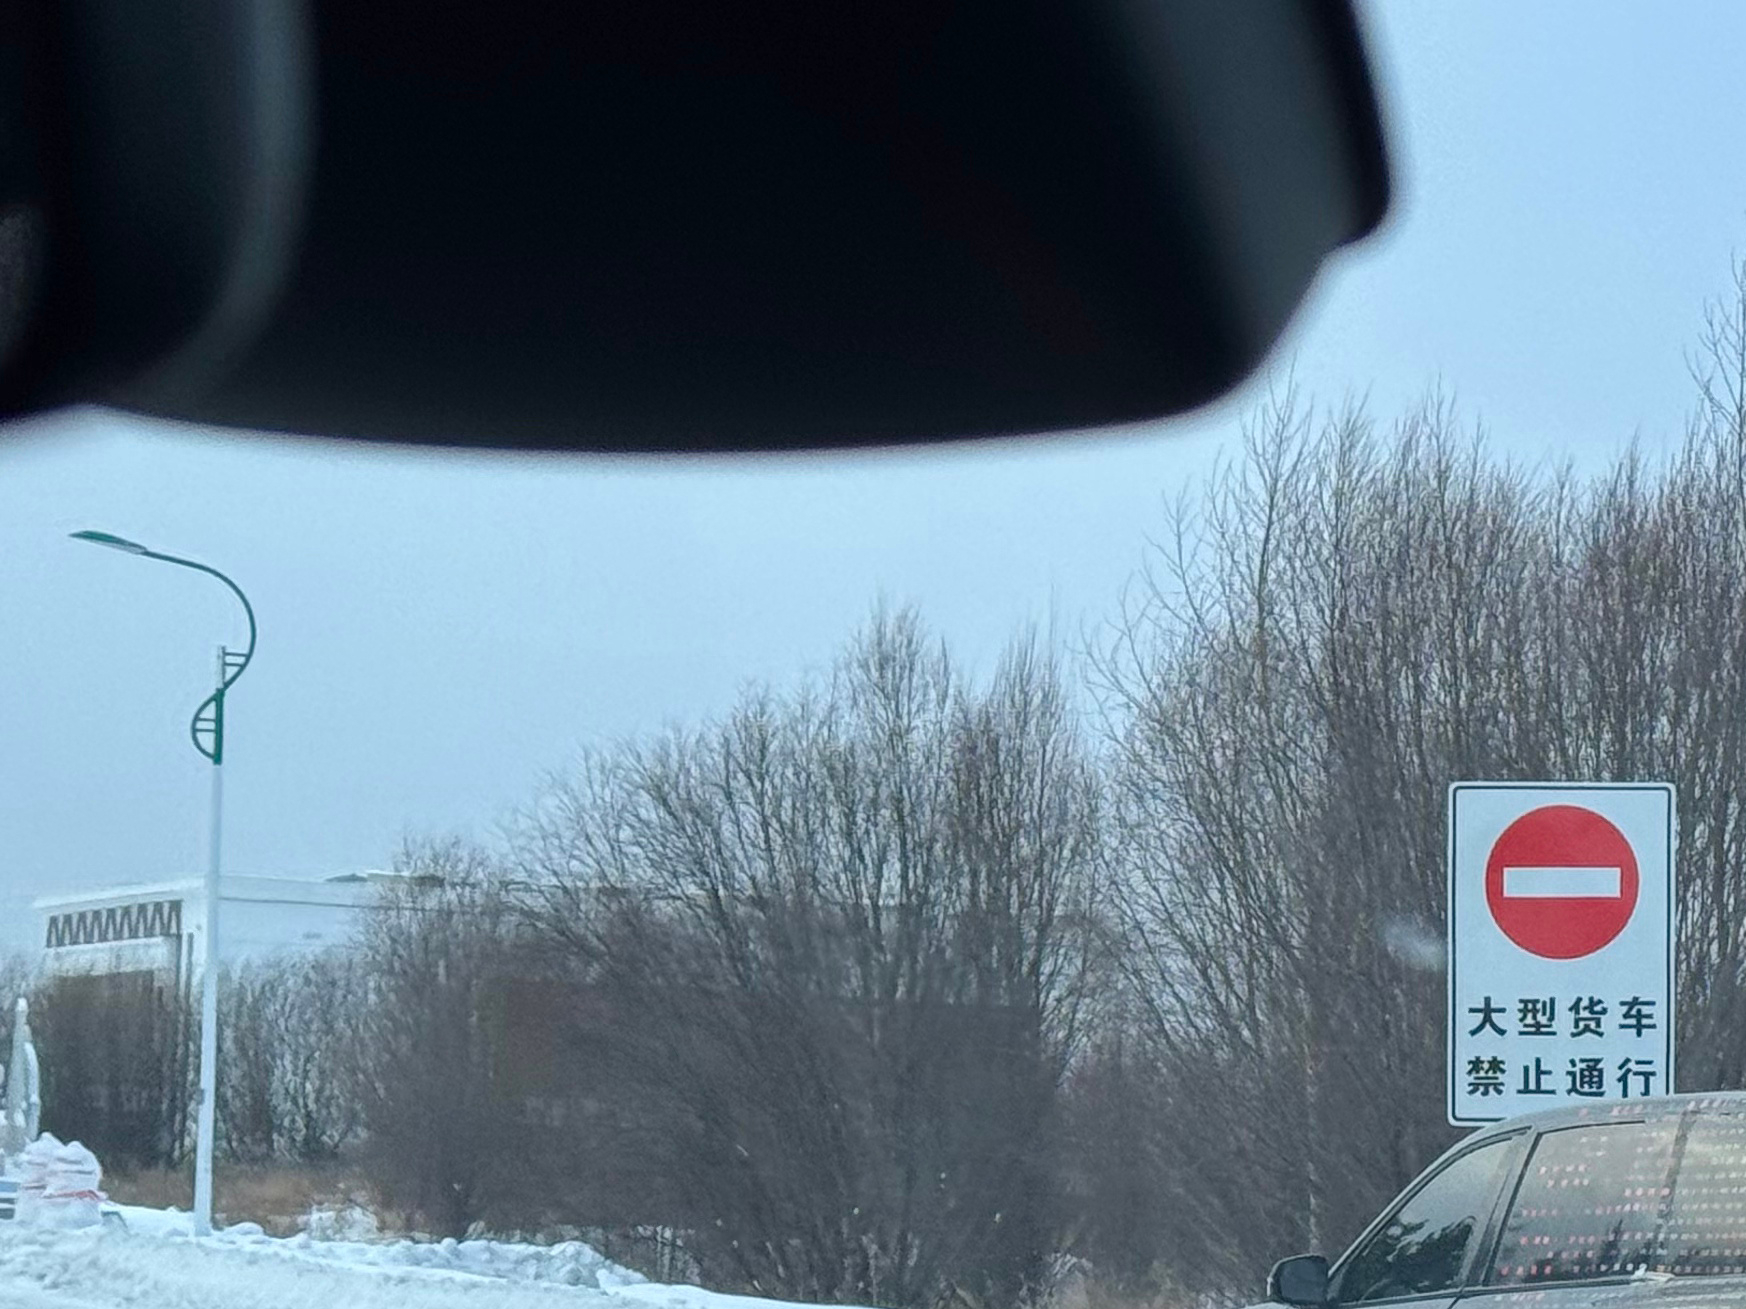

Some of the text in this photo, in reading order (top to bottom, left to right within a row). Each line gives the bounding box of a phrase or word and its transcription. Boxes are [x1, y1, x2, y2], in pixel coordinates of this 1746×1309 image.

[1467, 996, 1657, 1038] 大型货车
[1466, 1055, 1657, 1099] 禁止通行
